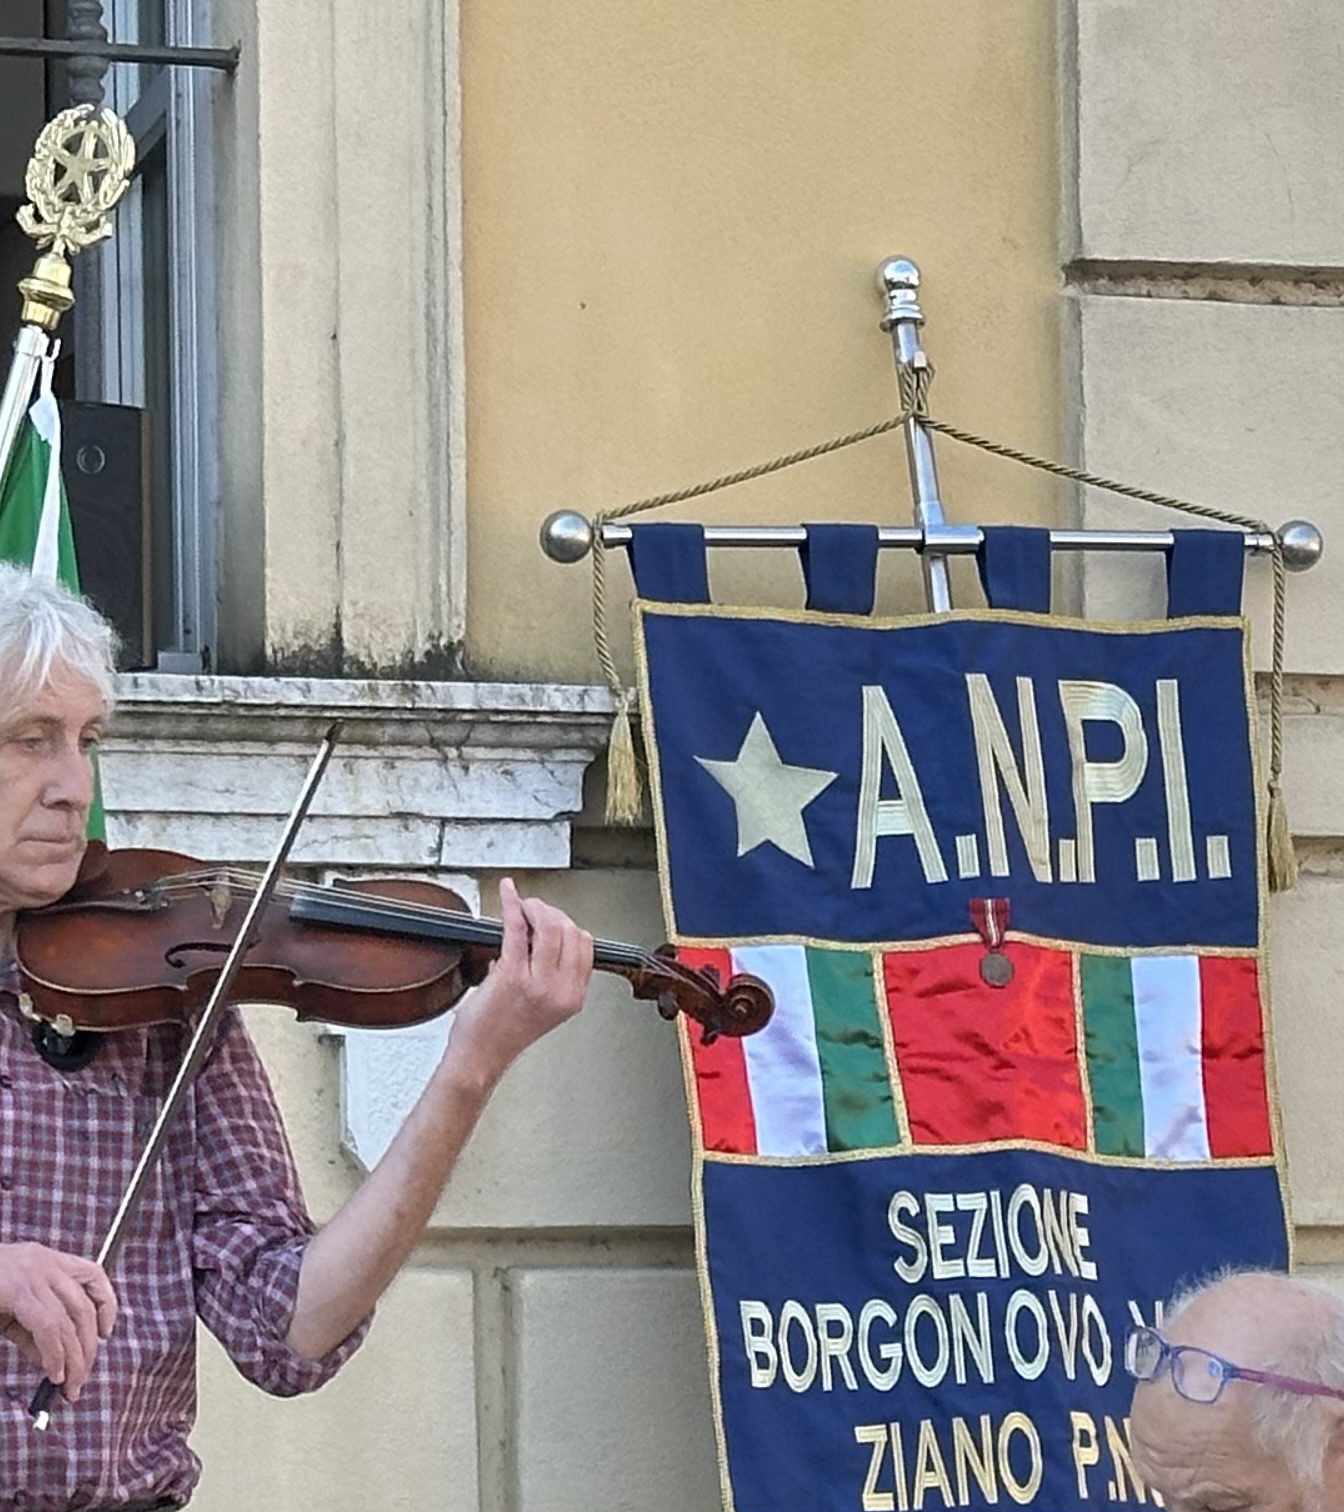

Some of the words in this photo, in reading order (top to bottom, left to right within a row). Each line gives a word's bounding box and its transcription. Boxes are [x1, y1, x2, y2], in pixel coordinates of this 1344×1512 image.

[851, 673, 1232, 889] A.N.P.I.
[888, 1183, 1098, 1284] SEZIONE
[855, 1411, 1043, 1512] ZIANO
